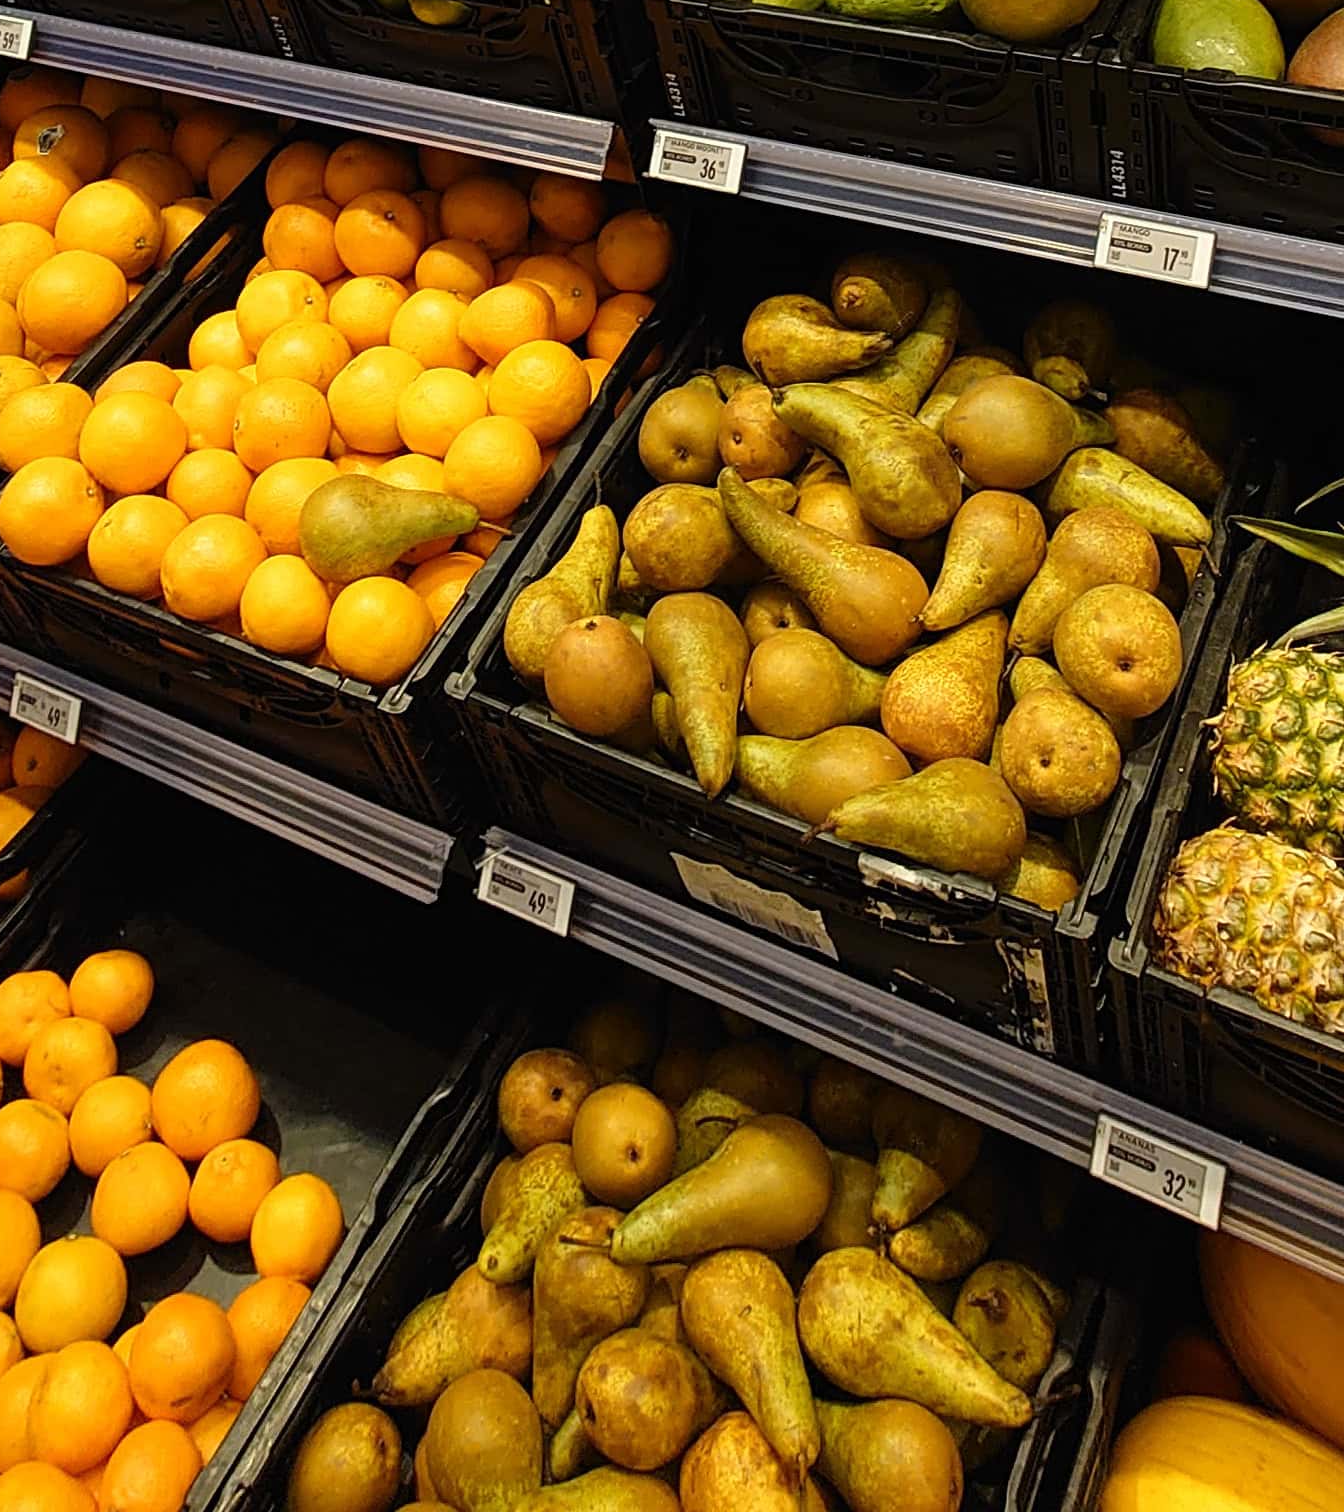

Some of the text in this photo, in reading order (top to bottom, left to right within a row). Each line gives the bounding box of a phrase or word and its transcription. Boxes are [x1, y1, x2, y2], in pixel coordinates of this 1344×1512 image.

[2, 31, 14, 50] 59
[665, 73, 686, 117] LL4314
[700, 159, 716, 180] 36
[1109, 150, 1127, 199] LL4314
[1119, 225, 1151, 237] MANGO
[1163, 247, 1179, 272] 17
[47, 706, 60, 727] 49
[528, 890, 546, 915] 49
[1119, 1133, 1157, 1154] ANANAS
[1163, 1169, 1187, 1202] 32
